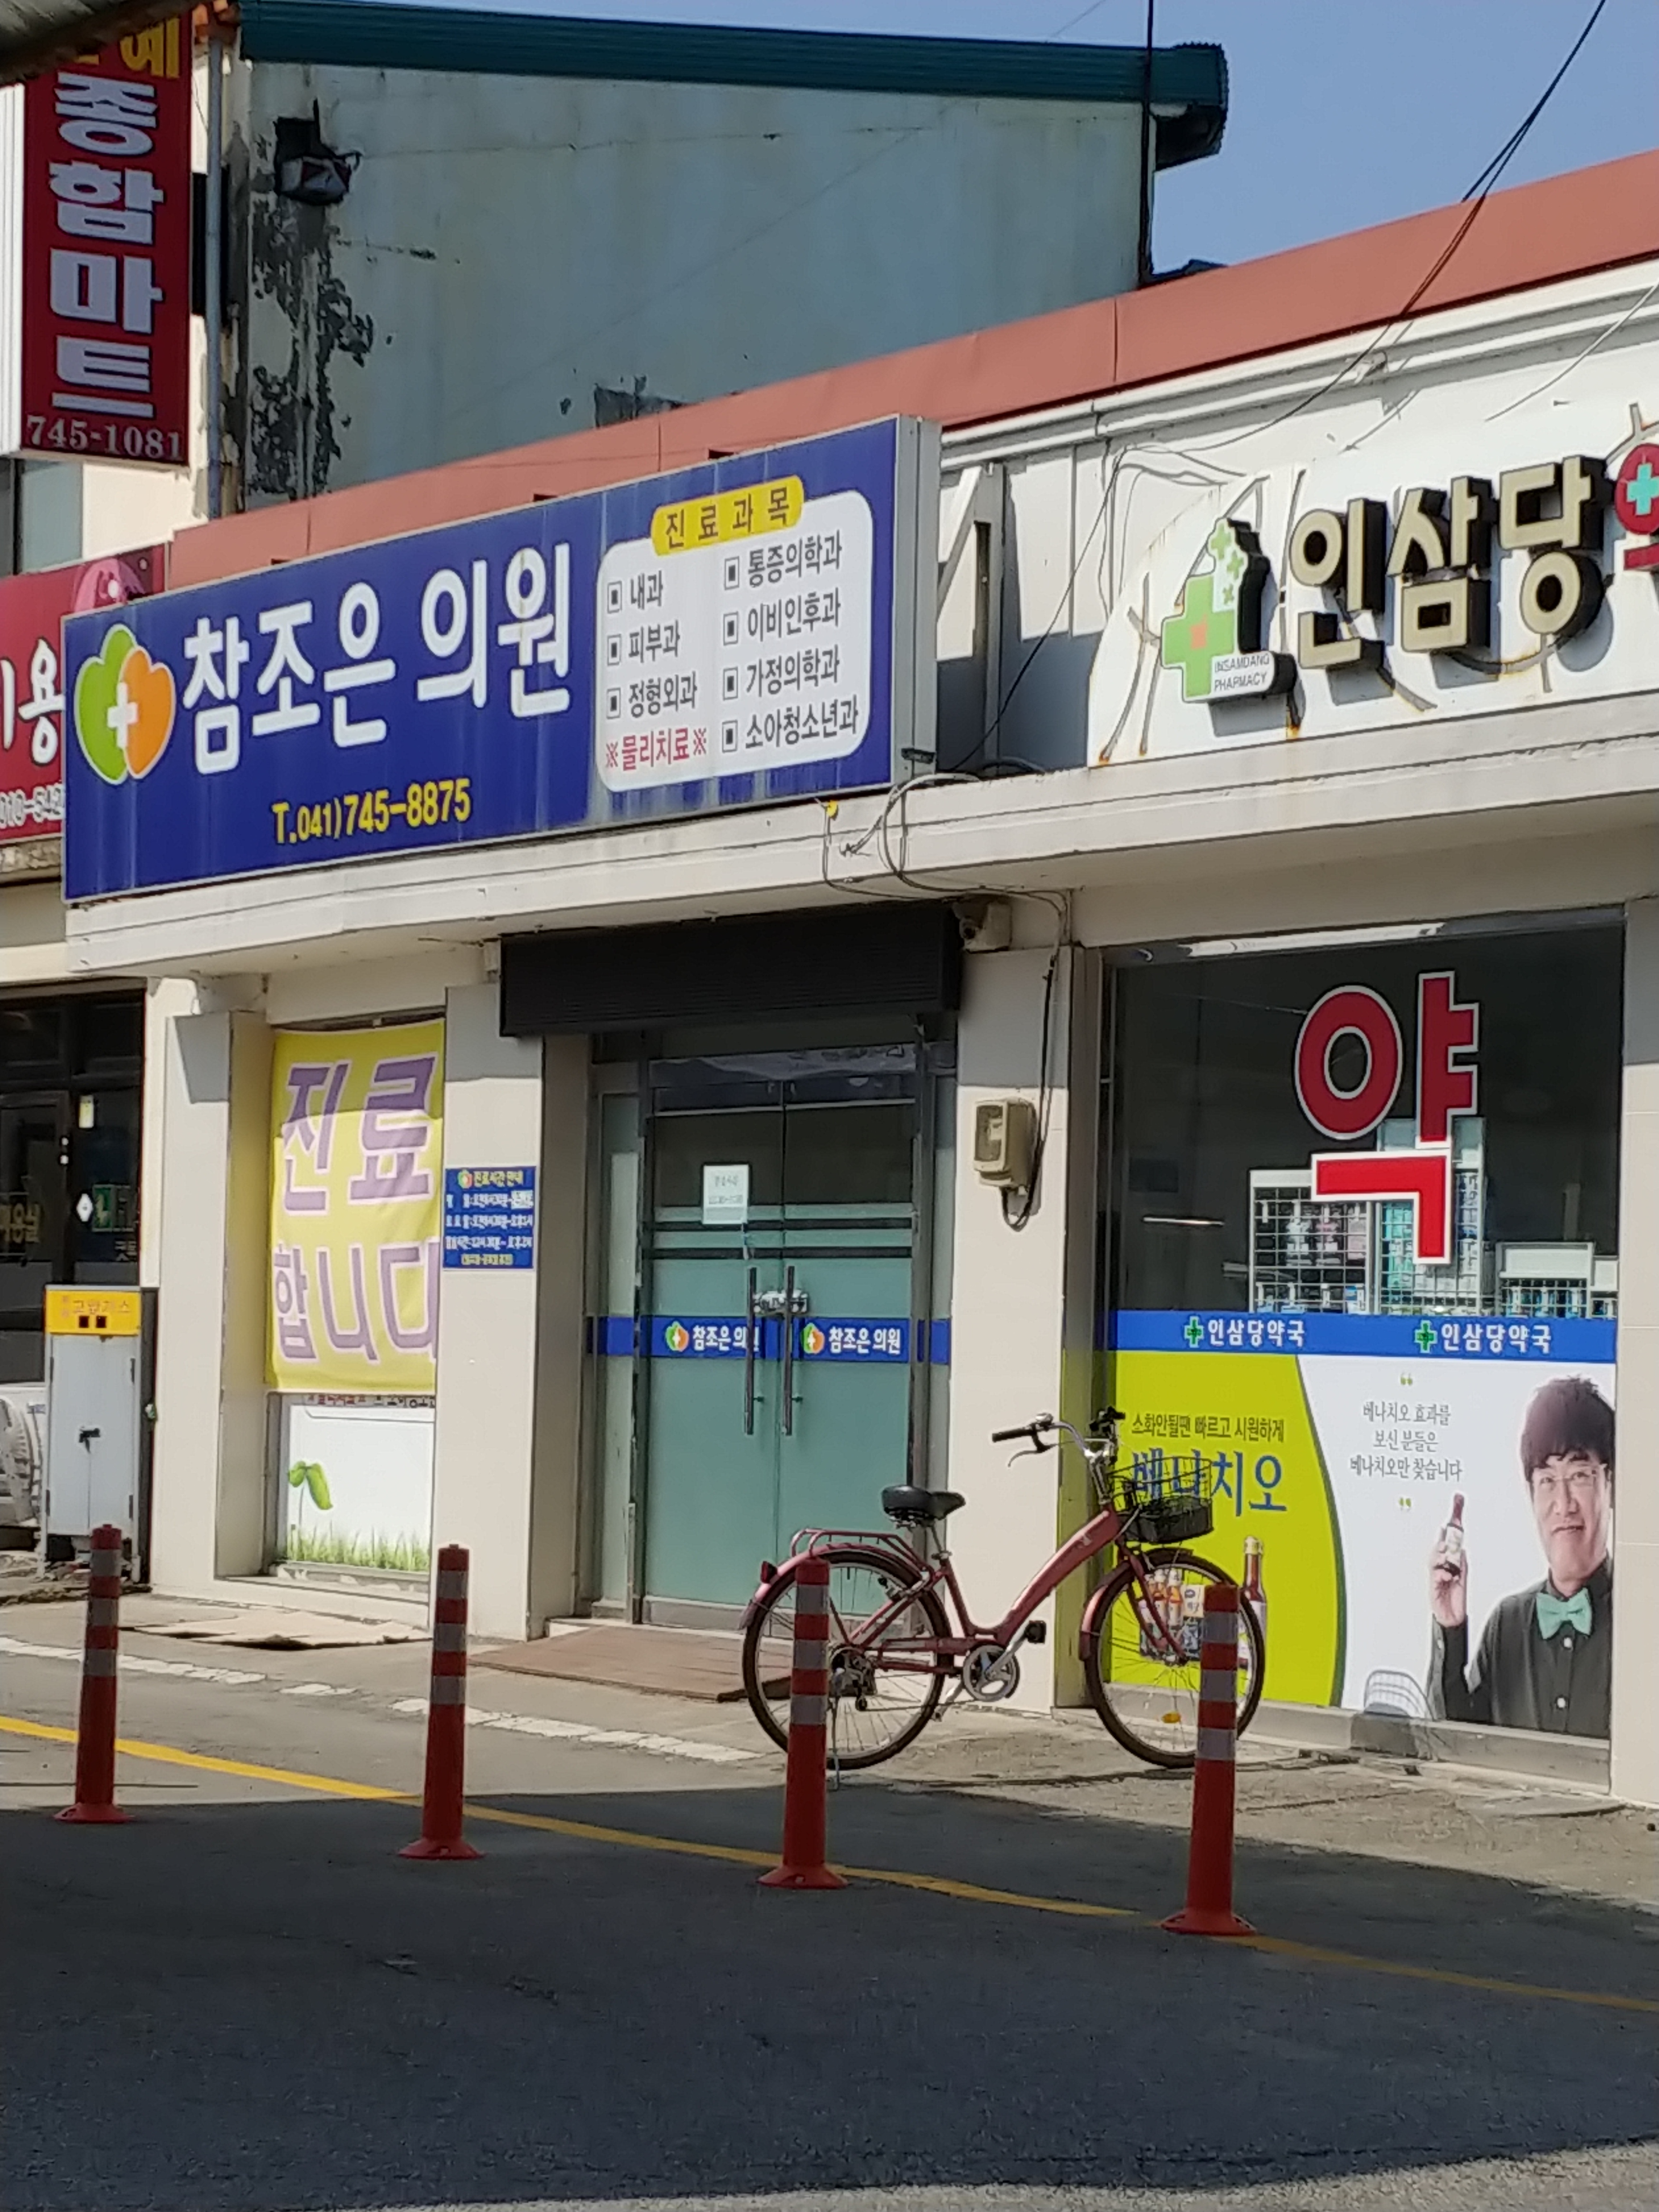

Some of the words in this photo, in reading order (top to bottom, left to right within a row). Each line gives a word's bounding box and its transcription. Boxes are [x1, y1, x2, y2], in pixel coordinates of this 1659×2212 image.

[49, 71, 164, 418] 종합마트
[27, 415, 183, 459] 745-1081
[748, 529, 842, 588] 통증의학과
[1289, 455, 1620, 670] 인삼당
[629, 570, 664, 610] 내과
[748, 587, 841, 642] 이비인후과
[183, 582, 396, 776] 참조은
[417, 542, 571, 719] 의원
[628, 620, 681, 663] 피부과
[1214, 653, 1269, 673] INSAMDANG
[746, 644, 840, 697] 가정의학과
[1214, 672, 1267, 692] PHARMACY
[628, 671, 698, 718] 정형외과
[745, 694, 858, 749] 소아청소년과
[284, 1052, 437, 1216] 진료
[1294, 970, 1479, 1264] 약
[692, 1325, 732, 1352] 참조은
[828, 1326, 871, 1354] 참조은
[872, 1327, 901, 1355] 의원
[1208, 1319, 1306, 1348] 인삼당약국
[1441, 1323, 1552, 1354] 인삼당약국
[1235, 1417, 1285, 1442] 시원하게
[1363, 1401, 1411, 1423] 베나치오
[1413, 1403, 1451, 1426] 효과를
[1373, 1429, 1399, 1450] 보신
[1401, 1430, 1439, 1452] 분들은
[1350, 1454, 1410, 1478] 베나치오만
[1412, 1458, 1463, 1482] 찾습니다
